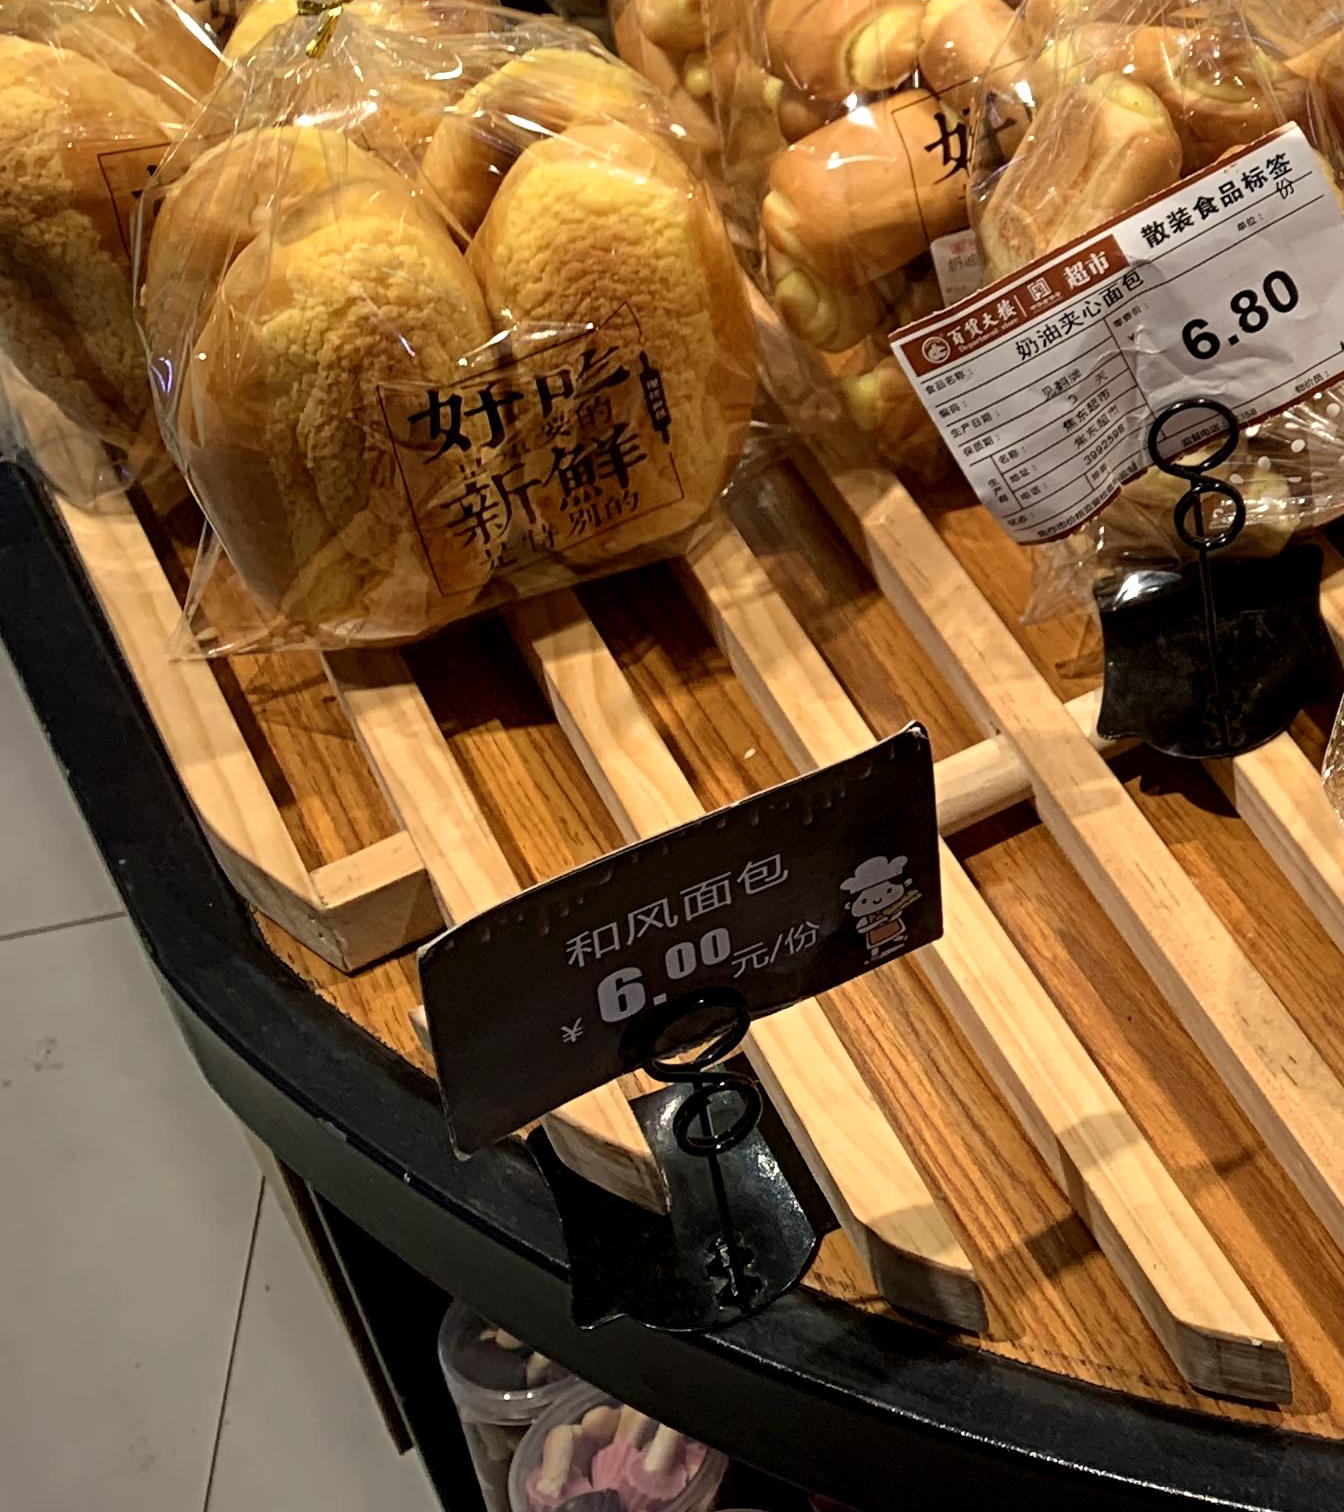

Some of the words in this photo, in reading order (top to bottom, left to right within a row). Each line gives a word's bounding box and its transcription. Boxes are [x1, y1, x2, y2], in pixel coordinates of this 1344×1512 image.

[1140, 152, 1292, 248] 散装食品标签
[1275, 177, 1295, 201] 份
[1016, 270, 1144, 360] 奶油夹心面包
[1064, 251, 1110, 289] 超市
[1182, 270, 1299, 360] 6.80
[407, 345, 630, 466] 好吃
[951, 409, 1000, 439] 生产日期：
[963, 434, 1001, 457] 保质期：
[1067, 392, 1079, 405] 3
[999, 446, 1027, 465] 名称：
[566, 854, 789, 968] 和风面包
[597, 928, 732, 1023] 6.00
[731, 919, 820, 978] 元/份
